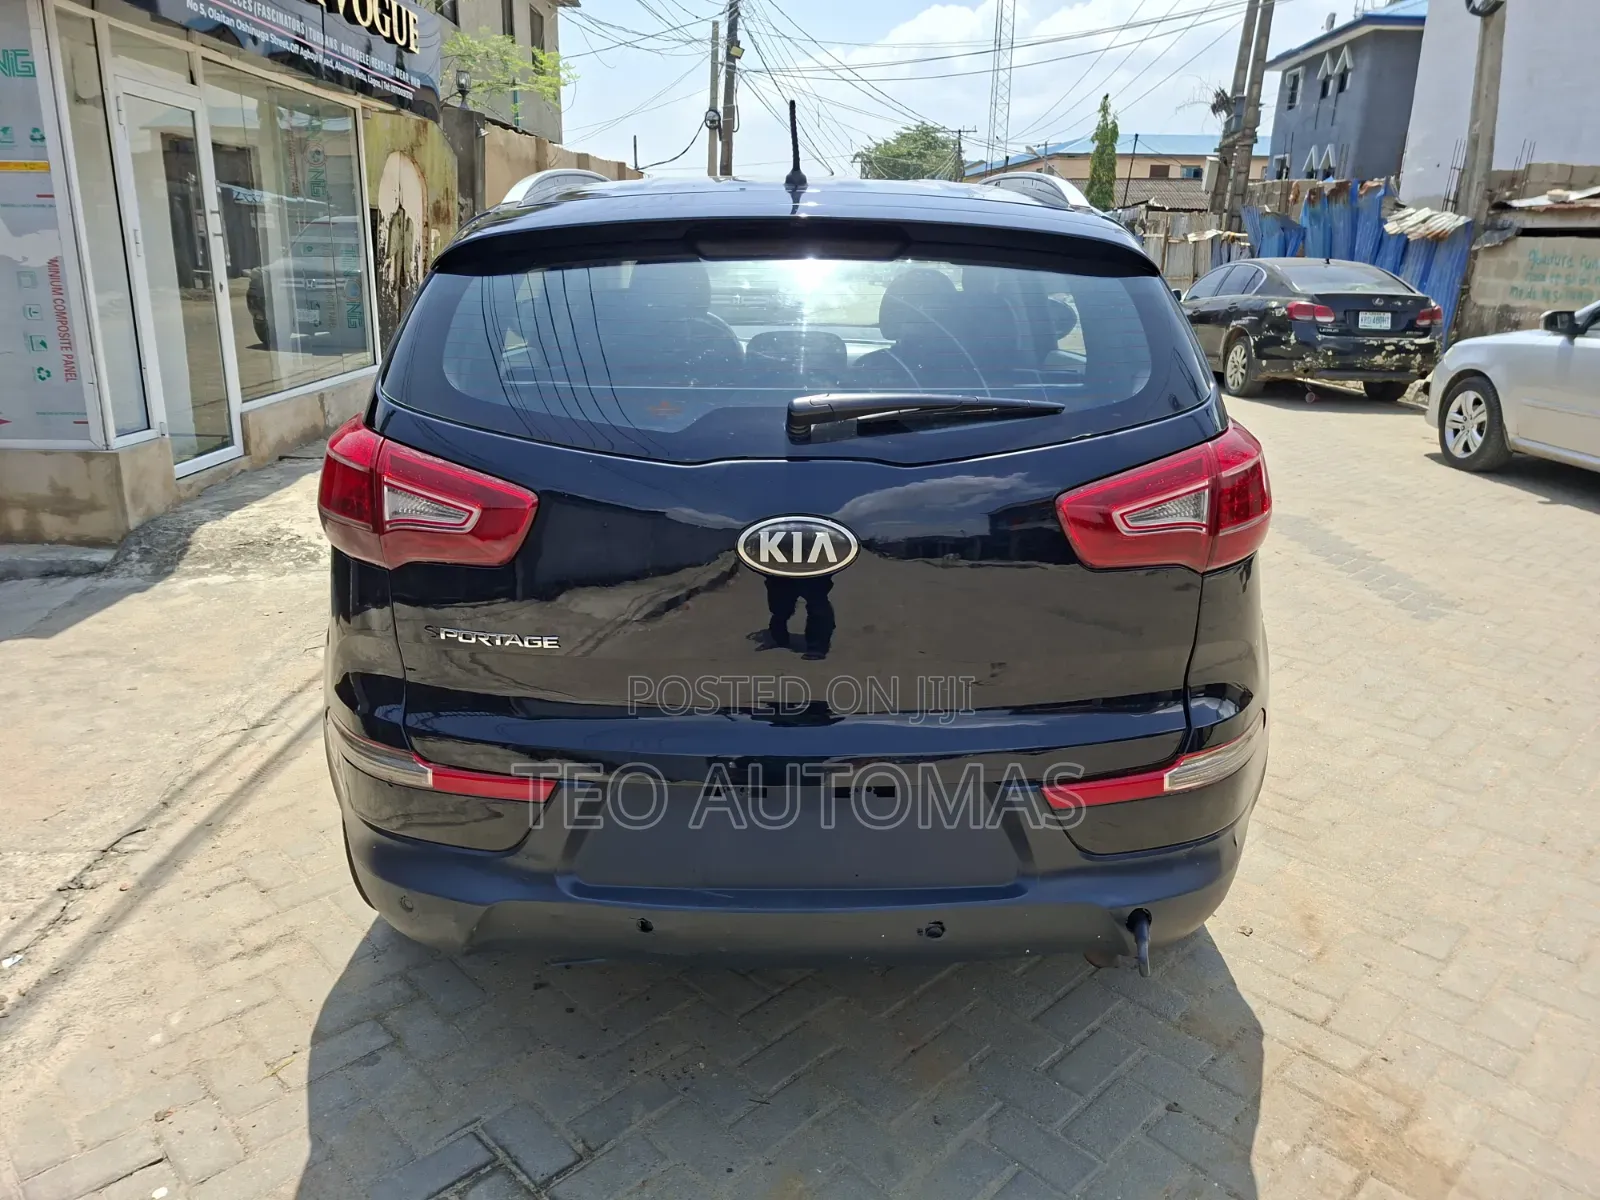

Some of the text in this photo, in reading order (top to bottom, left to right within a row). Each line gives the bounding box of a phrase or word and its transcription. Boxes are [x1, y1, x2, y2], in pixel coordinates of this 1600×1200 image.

[187, 0, 199, 12] No
[199, 3, 207, 18] 5,
[208, 7, 235, 28] Olaitan
[236, 18, 270, 43] Oshinuga
[46, 256, 78, 383] MINIUM COMPOSITE PANEL
[758, 531, 838, 563] KIA
[424, 625, 561, 649] SPORTAGE
